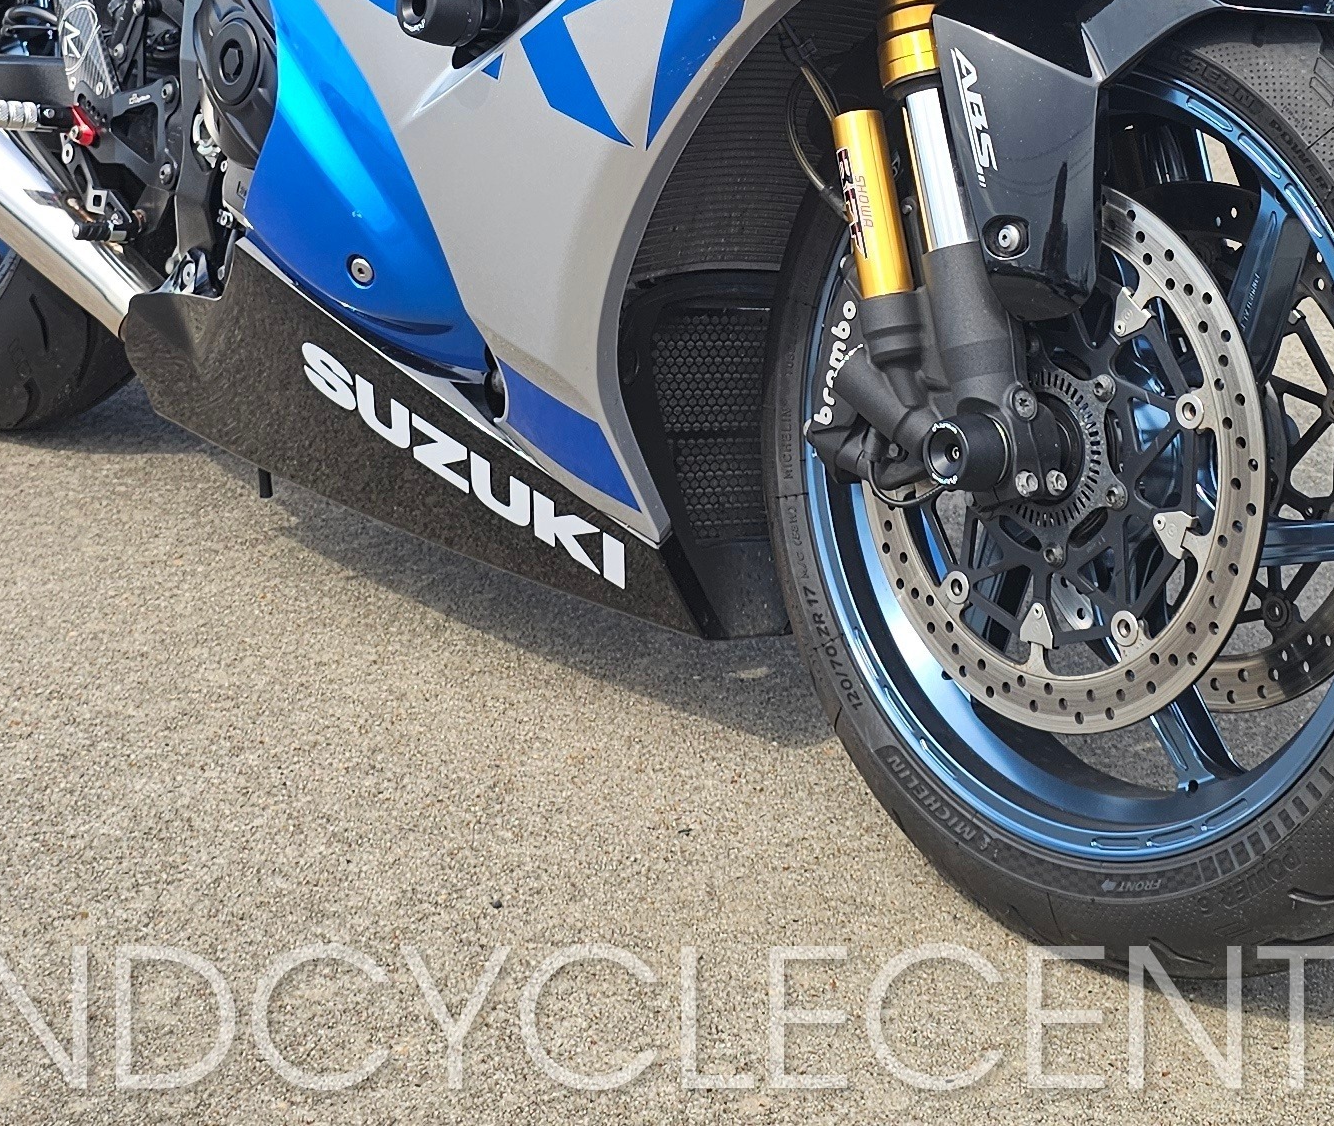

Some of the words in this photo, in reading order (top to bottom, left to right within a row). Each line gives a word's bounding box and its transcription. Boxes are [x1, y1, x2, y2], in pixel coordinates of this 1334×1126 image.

[950, 46, 998, 188] ABS
[1268, 117, 1328, 194] POWER
[855, 175, 875, 228] SHOWA
[301, 341, 626, 591] SUZUKI
[805, 588, 820, 609] 17
[811, 613, 831, 640] ZR
[825, 645, 864, 712] 120/70
[886, 753, 977, 843] MICHELIN
[1117, 878, 1162, 893] FRONT
[1221, 852, 1302, 911] POWER
